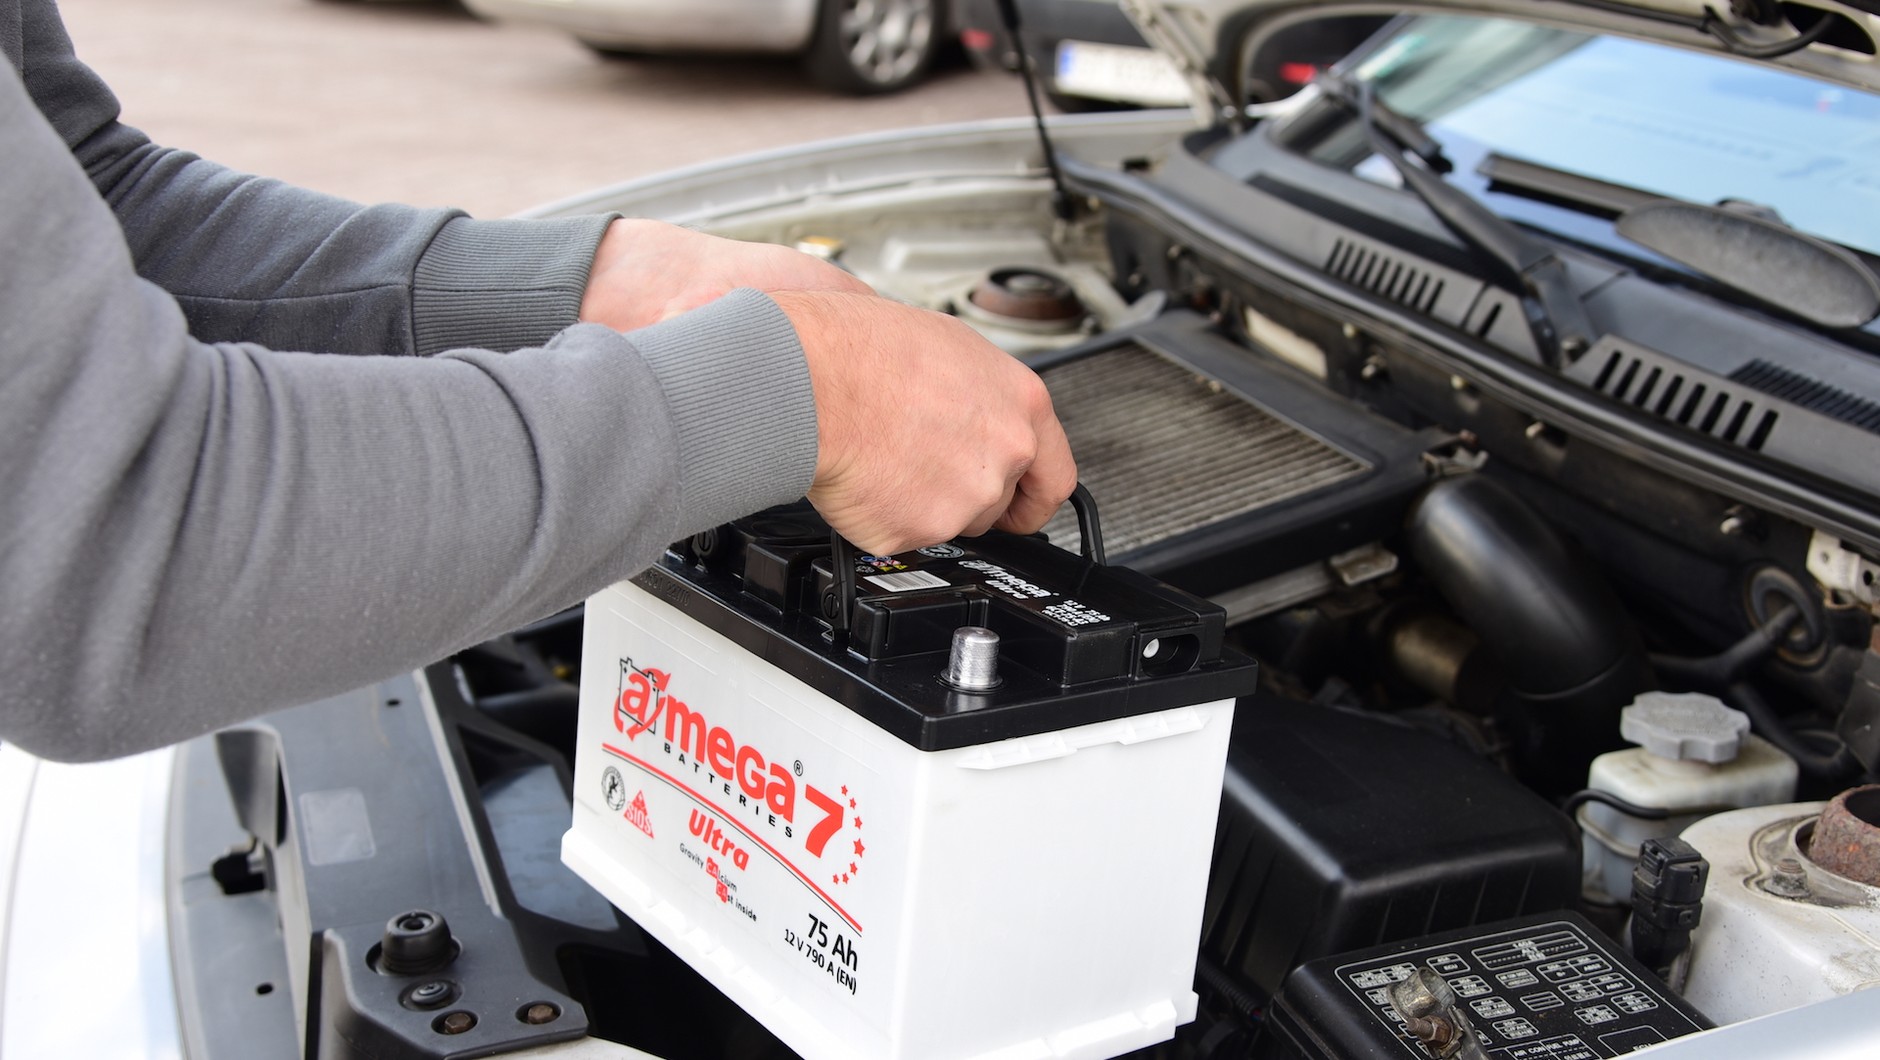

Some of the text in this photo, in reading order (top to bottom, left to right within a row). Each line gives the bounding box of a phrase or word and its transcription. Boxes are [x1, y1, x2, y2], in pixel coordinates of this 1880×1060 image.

[664, 742, 793, 838] BATTERIES
[689, 808, 749, 871] Ultra
[805, 784, 844, 858] 7
[680, 843, 704, 869] Gravity
[735, 898, 757, 922] inside
[785, 928, 857, 996] 12 V 790 A (EN)
[808, 913, 858, 972] 75 Ah
[1513, 1045, 1546, 1057] AIR CON
